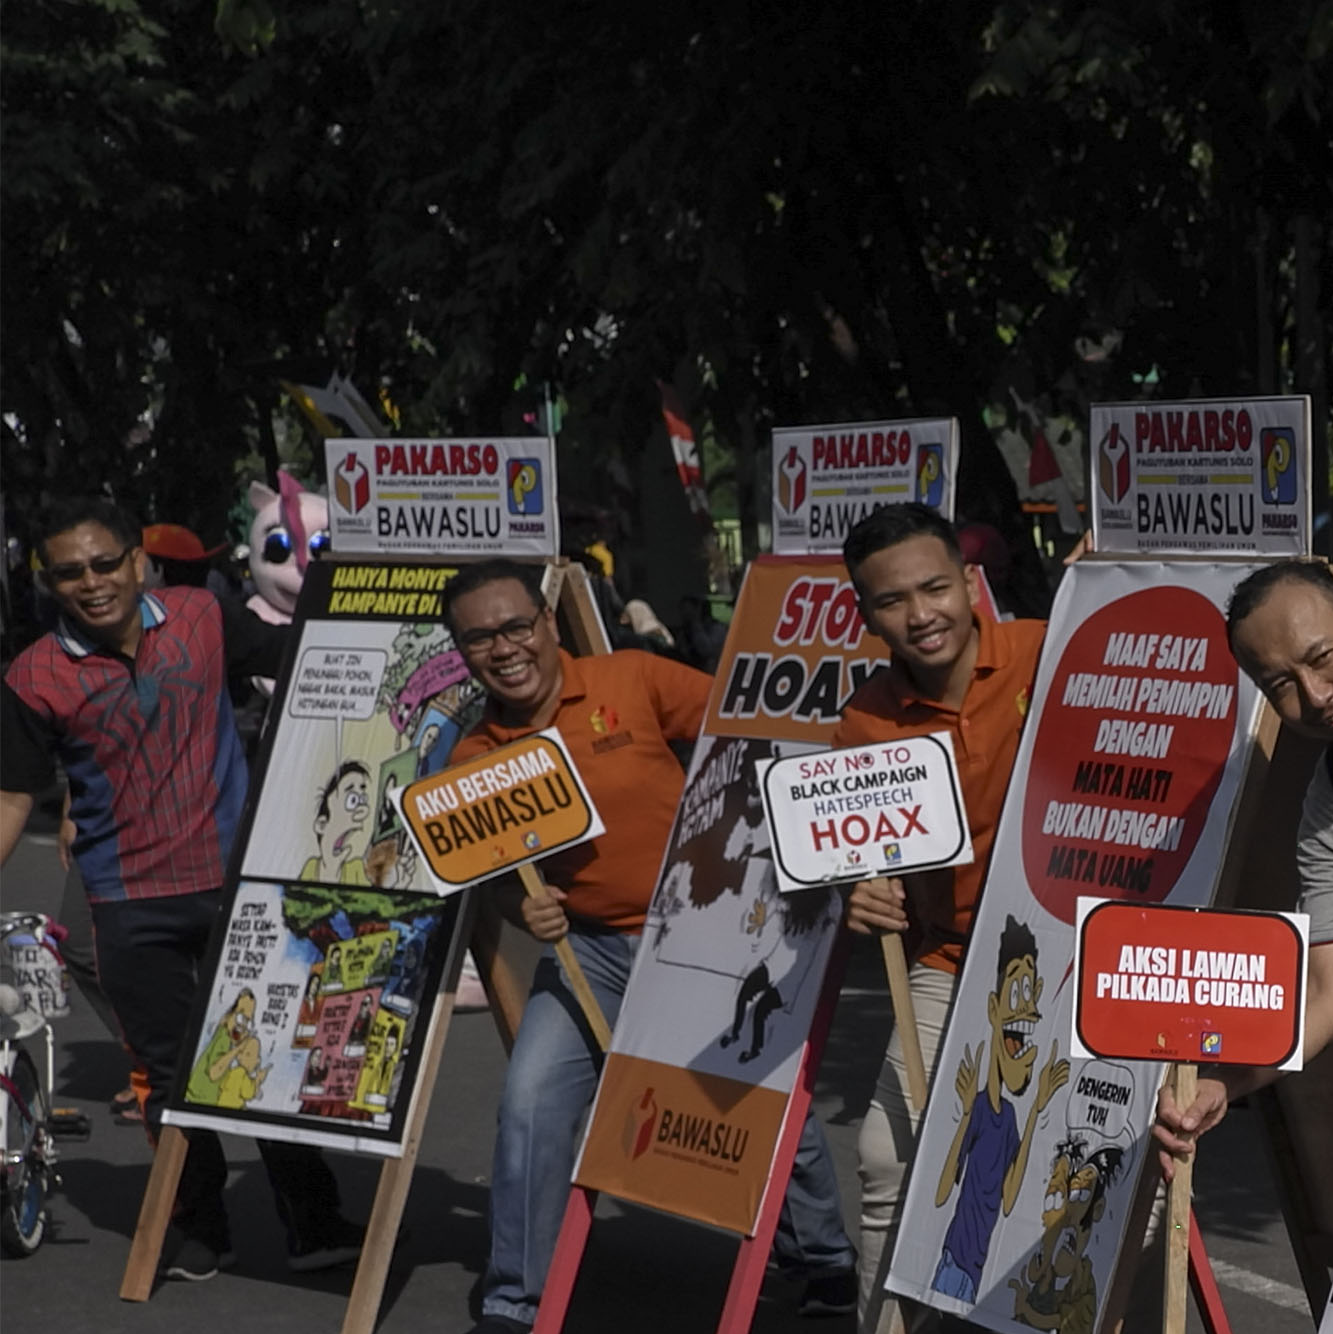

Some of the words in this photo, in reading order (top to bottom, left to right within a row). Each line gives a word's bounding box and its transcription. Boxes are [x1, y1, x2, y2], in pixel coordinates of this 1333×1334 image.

[813, 431, 911, 470] PAKARSO
[1135, 409, 1253, 453] PAKARSO
[375, 444, 499, 476] PAKARSO
[1136, 457, 1186, 467] PAGUYUBAN
[1187, 457, 1229, 467] KARTUNIS
[1230, 456, 1253, 467] SOLO
[377, 506, 501, 538] BAWASLU
[1137, 493, 1255, 536] BAWASLU
[1262, 513, 1298, 530] PAKARSO
[331, 565, 389, 590] HANYA
[328, 591, 418, 616] KAMPANYE
[1103, 632, 1158, 669] MAAF
[1155, 634, 1209, 673] SAYA
[1062, 673, 1138, 712] MEMILIH
[1134, 677, 1234, 720] PEMIMPIN
[1093, 719, 1175, 759] DENGAN
[790, 778, 841, 801] BLACK
[843, 765, 928, 792] CAMPAIGN
[800, 758, 836, 780] SAY
[844, 753, 875, 772] NO
[882, 747, 911, 766] TO
[1072, 761, 1125, 799] MATA
[1125, 767, 1174, 803] HATI
[414, 783, 460, 821] AKU
[456, 746, 557, 804] BERSAMA
[813, 787, 914, 816] HATESPEECH
[424, 772, 573, 857] BAWASLU
[810, 804, 931, 852] HOAX
[1042, 800, 1108, 843] BUKAN
[1103, 808, 1186, 853] DENGAN
[1046, 846, 1100, 884] MATA
[1098, 854, 1155, 894] UANG
[1118, 944, 1177, 977] AKSI
[1181, 950, 1267, 983] LAWAN
[1096, 972, 1191, 1005] PILKADA
[1194, 979, 1285, 1011] CURANG
[1077, 1076, 1131, 1106] DENGERIN
[658, 1108, 750, 1163] BAWASLU
[1087, 1104, 1110, 1128] TUH
